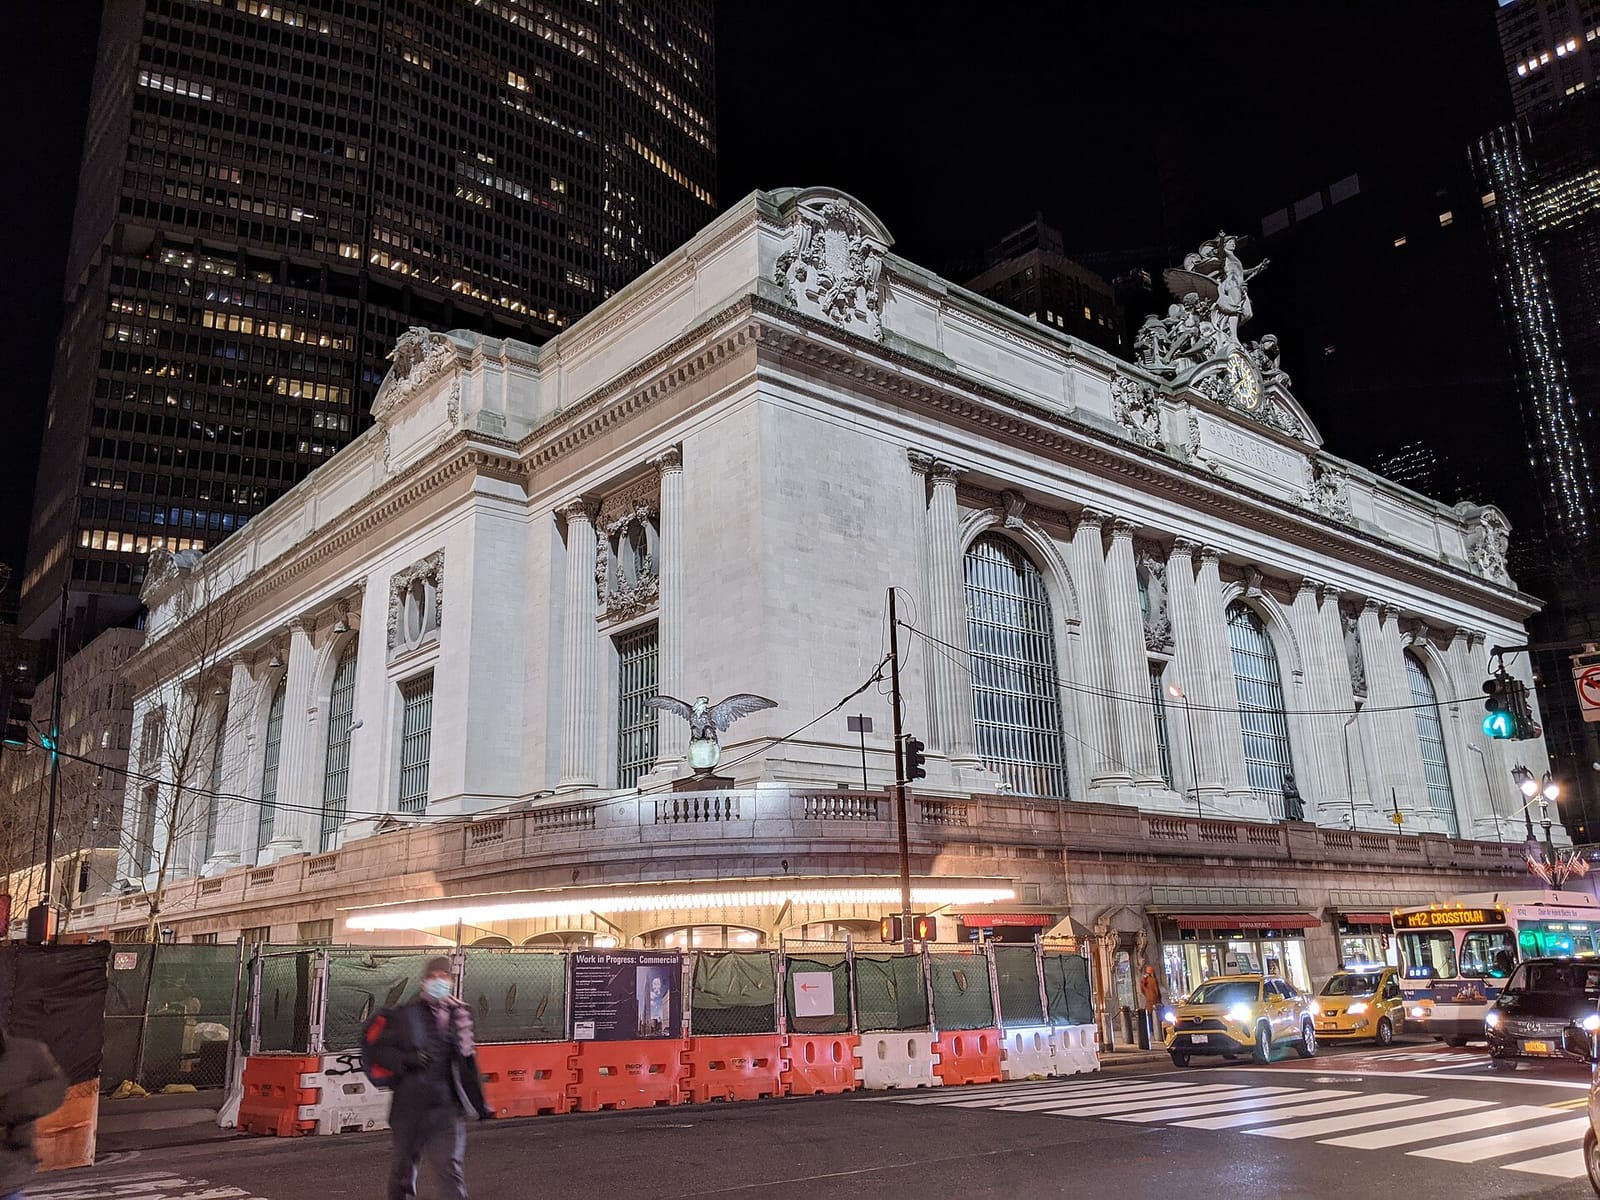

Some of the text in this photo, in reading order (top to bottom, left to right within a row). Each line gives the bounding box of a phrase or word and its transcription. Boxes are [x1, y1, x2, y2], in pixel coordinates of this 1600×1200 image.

[1209, 424, 1292, 468] GRAND CENTRAL
[1229, 443, 1277, 472] TERMINAL
[1408, 910, 1484, 926] M42 CROSSTOWN
[576, 954, 679, 965] Work in Progress: Commercial
